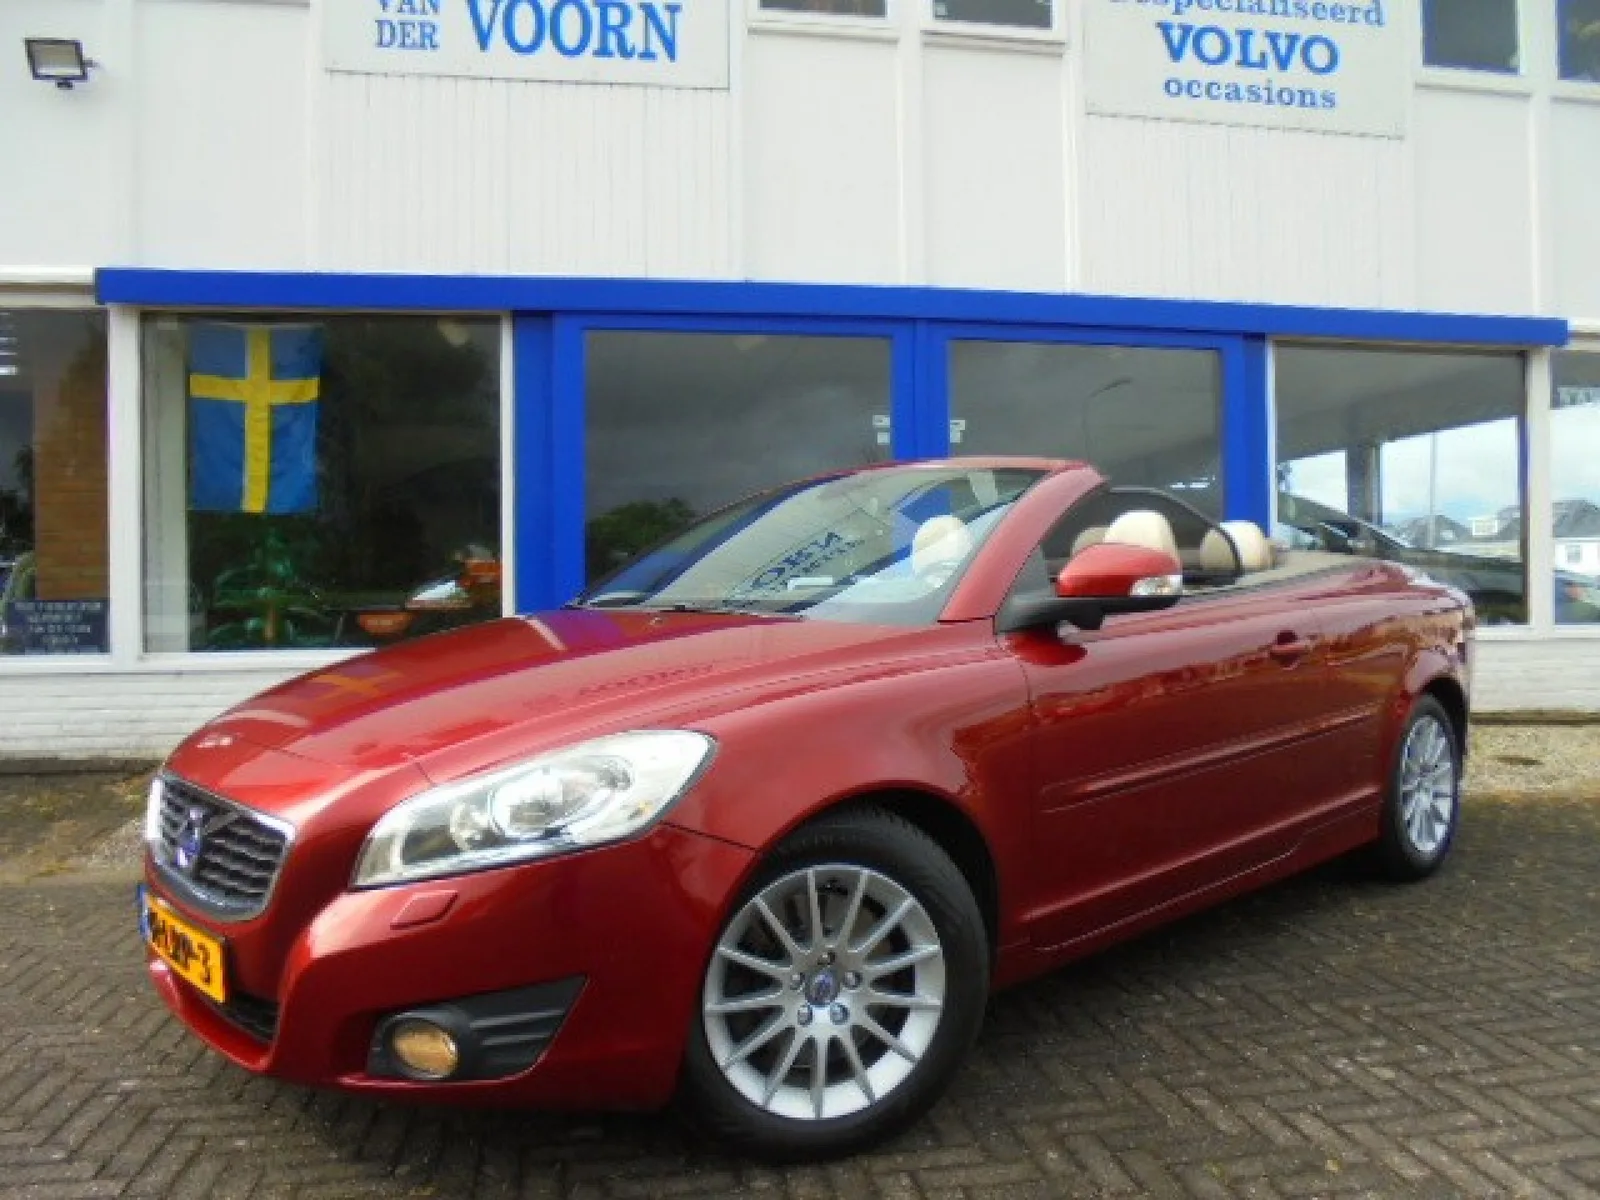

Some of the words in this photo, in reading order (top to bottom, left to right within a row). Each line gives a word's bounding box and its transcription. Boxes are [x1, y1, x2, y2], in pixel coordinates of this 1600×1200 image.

[375, 20, 440, 51] DER
[465, 0, 683, 63] VOORN
[1155, 21, 1341, 76] VOLVO
[1163, 77, 1337, 109] occasions
